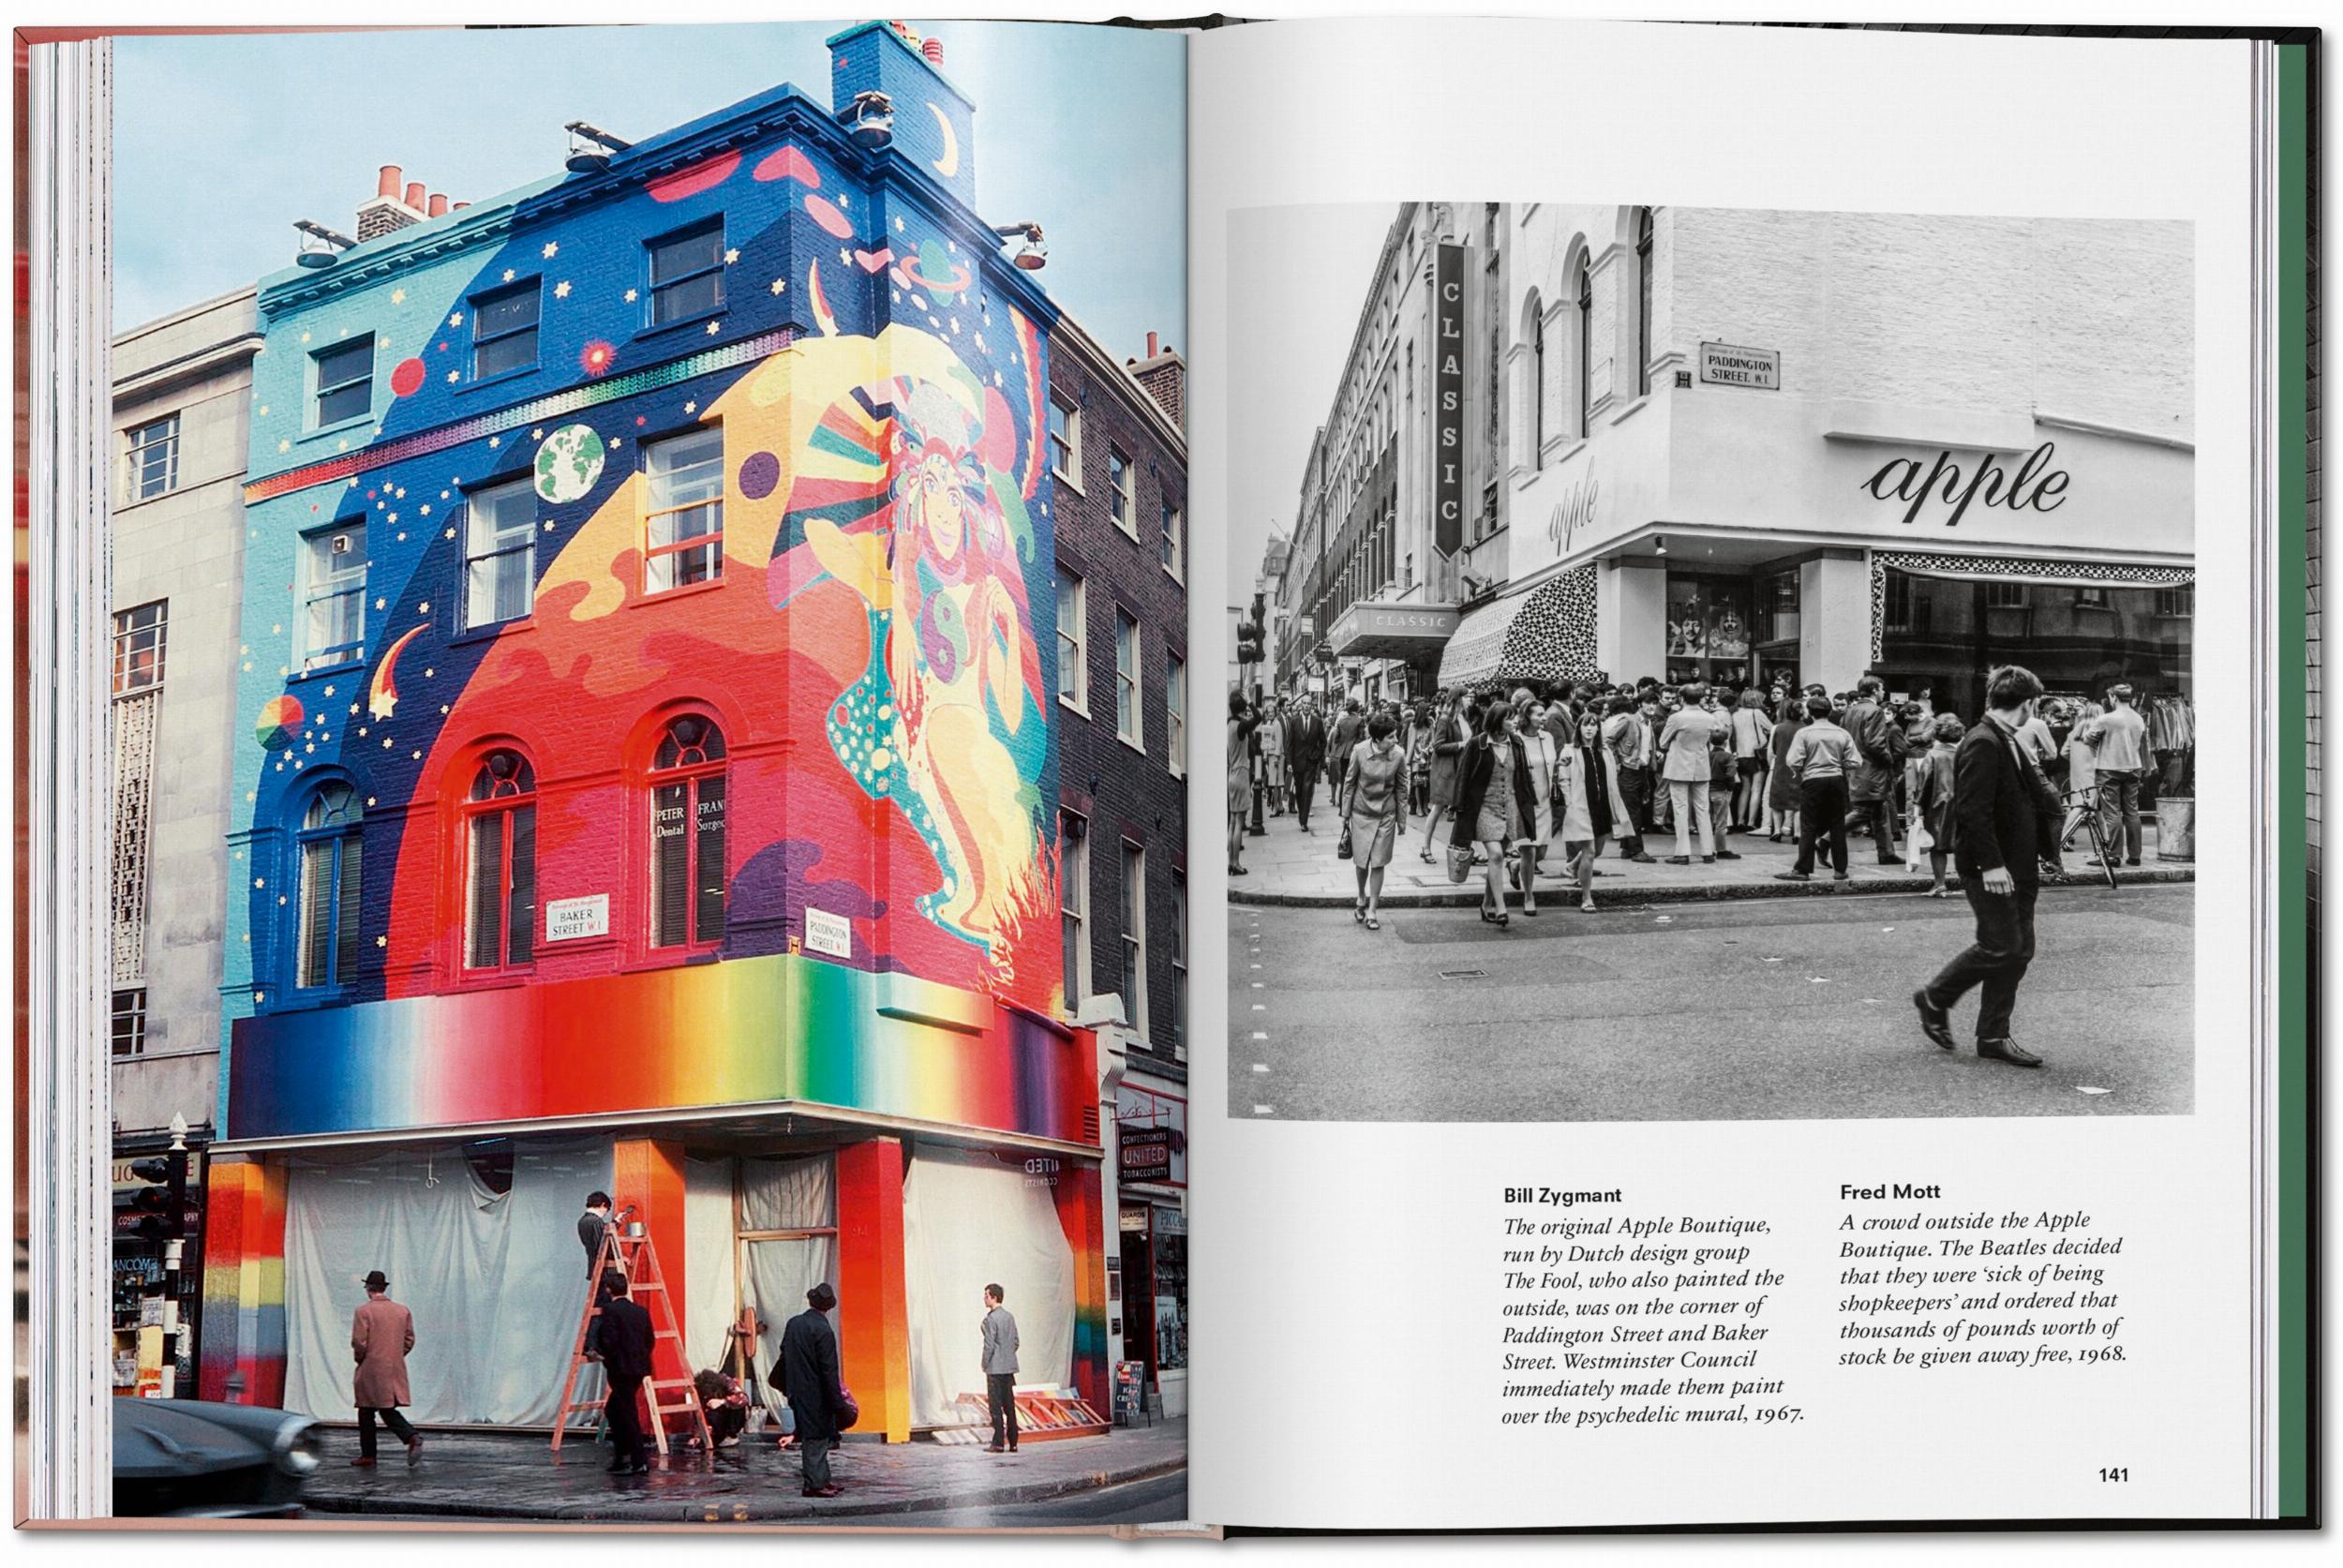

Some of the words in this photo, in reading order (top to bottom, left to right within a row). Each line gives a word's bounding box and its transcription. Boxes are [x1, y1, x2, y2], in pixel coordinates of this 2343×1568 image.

[1709, 355, 1772, 372] PADDINGTON
[1441, 282, 1461, 521] CLASSIC
[1859, 441, 2070, 527] apple
[1549, 455, 1599, 557] apple
[1375, 615, 1447, 628] CLASSIC
[657, 807, 684, 822] PETER
[657, 824, 684, 838] Dental
[560, 908, 593, 922] BAKER
[553, 922, 585, 936] STREET
[1124, 1146, 1167, 1164] UNITED
[1123, 1168, 1168, 1178] TOBACCONISTS
[1504, 1187, 1533, 1203] Bill
[1538, 1187, 1622, 1208] Zygmant
[1841, 1184, 1886, 1201] Fred
[1893, 1183, 1941, 1200] Mott
[1504, 1217, 1536, 1235] The
[1541, 1217, 1613, 1240] original
[1617, 1216, 1674, 1239] Apple
[1679, 1216, 1771, 1237] Boutique,
[1838, 1214, 1855, 1231] A
[1862, 1212, 1922, 1231] crowd
[1925, 1211, 1994, 1230] outside
[2000, 1211, 2029, 1229] the
[2034, 1210, 2091, 1232] Apple
[1503, 1250, 1535, 1262] run
[1540, 1245, 1563, 1268] by
[1567, 1244, 1624, 1262] Dutch
[1630, 1244, 1688, 1266] design
[1693, 1246, 1751, 1266] group
[1839, 1240, 1933, 1262] Boutique.
[1939, 1239, 1974, 1257] The
[1978, 1238, 2048, 1256] Beatles
[2052, 1236, 2124, 1255] decided
[1504, 1271, 1535, 1290] The
[1540, 1271, 1583, 1291] Fool,
[1589, 1270, 1627, 1289] who
[1631, 1270, 1669, 1288] also
[1673, 1268, 1751, 1292] painted
[1754, 1268, 1784, 1286] the
[1840, 1267, 1881, 1285] that
[1886, 1266, 1928, 1289] they
[1933, 1271, 1977, 1283] were
[2028, 1262, 2052, 1287] of
[2052, 1263, 2105, 1286] being
[1502, 1298, 1569, 1317] outside,
[1575, 1304, 1610, 1316] was
[1615, 1303, 1639, 1315] on
[1645, 1297, 1675, 1315] the
[1679, 1302, 1739, 1315] corner
[1744, 1294, 1768, 1319] of
[1961, 1292, 2001, 1310] and
[2004, 1291, 2076, 1309] ordered
[2080, 1291, 2119, 1308] that
[1502, 1325, 1604, 1349] Paddington
[1610, 1325, 1664, 1343] Street
[1667, 1323, 1709, 1342] and
[1711, 1323, 1769, 1341] Baker
[1840, 1320, 1936, 1339] thousands
[1943, 1319, 1966, 1342] of
[1965, 1319, 2037, 1341] pounds
[2042, 1318, 2097, 1336] worth
[2101, 1316, 2125, 1340] of
[1502, 1352, 1556, 1370] Street.
[1563, 1351, 1676, 1369] Westminster
[1680, 1350, 1758, 1368] Council
[1838, 1347, 1887, 1366] stock
[1892, 1347, 1916, 1365] be
[1918, 1346, 1972, 1369] given
[1977, 1351, 2030, 1367] away
[2029, 1343, 2072, 1367] free,
[2078, 1345, 2127, 1366] 1968.
[1502, 1379, 1615, 1401] immediately
[1619, 1378, 1672, 1396] made
[1678, 1378, 1725, 1396] them
[1729, 1377, 1784, 1399] paint
[1501, 1412, 1540, 1425] over
[1544, 1406, 1572, 1425] the
[1574, 1405, 1680, 1428] psychedelic
[1685, 1403, 1748, 1424] mural,
[1754, 1405, 1804, 1425] 1967.
[2098, 1467, 2128, 1483] 141
